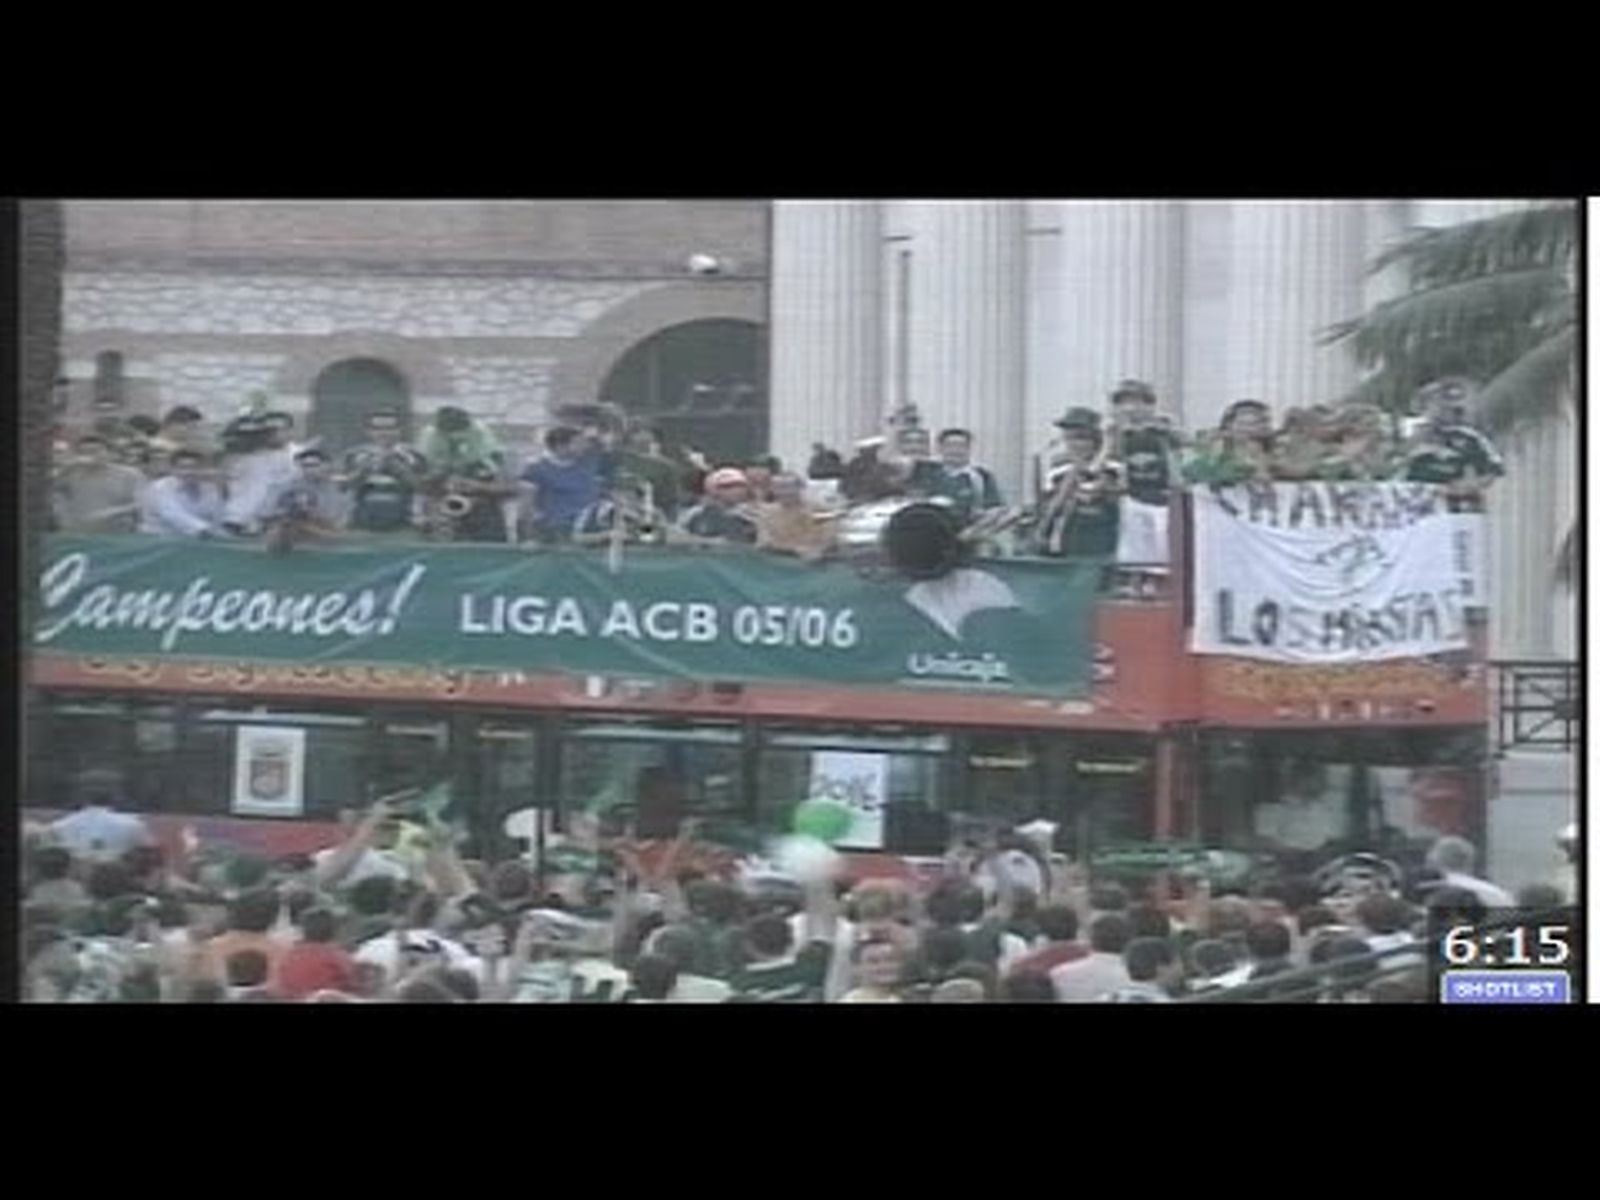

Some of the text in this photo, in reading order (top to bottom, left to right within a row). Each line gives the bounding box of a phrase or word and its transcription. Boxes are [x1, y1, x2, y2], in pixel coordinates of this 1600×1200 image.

[34, 553, 427, 651] Campeones!
[460, 595, 859, 648] LIGA ACB 05/06
